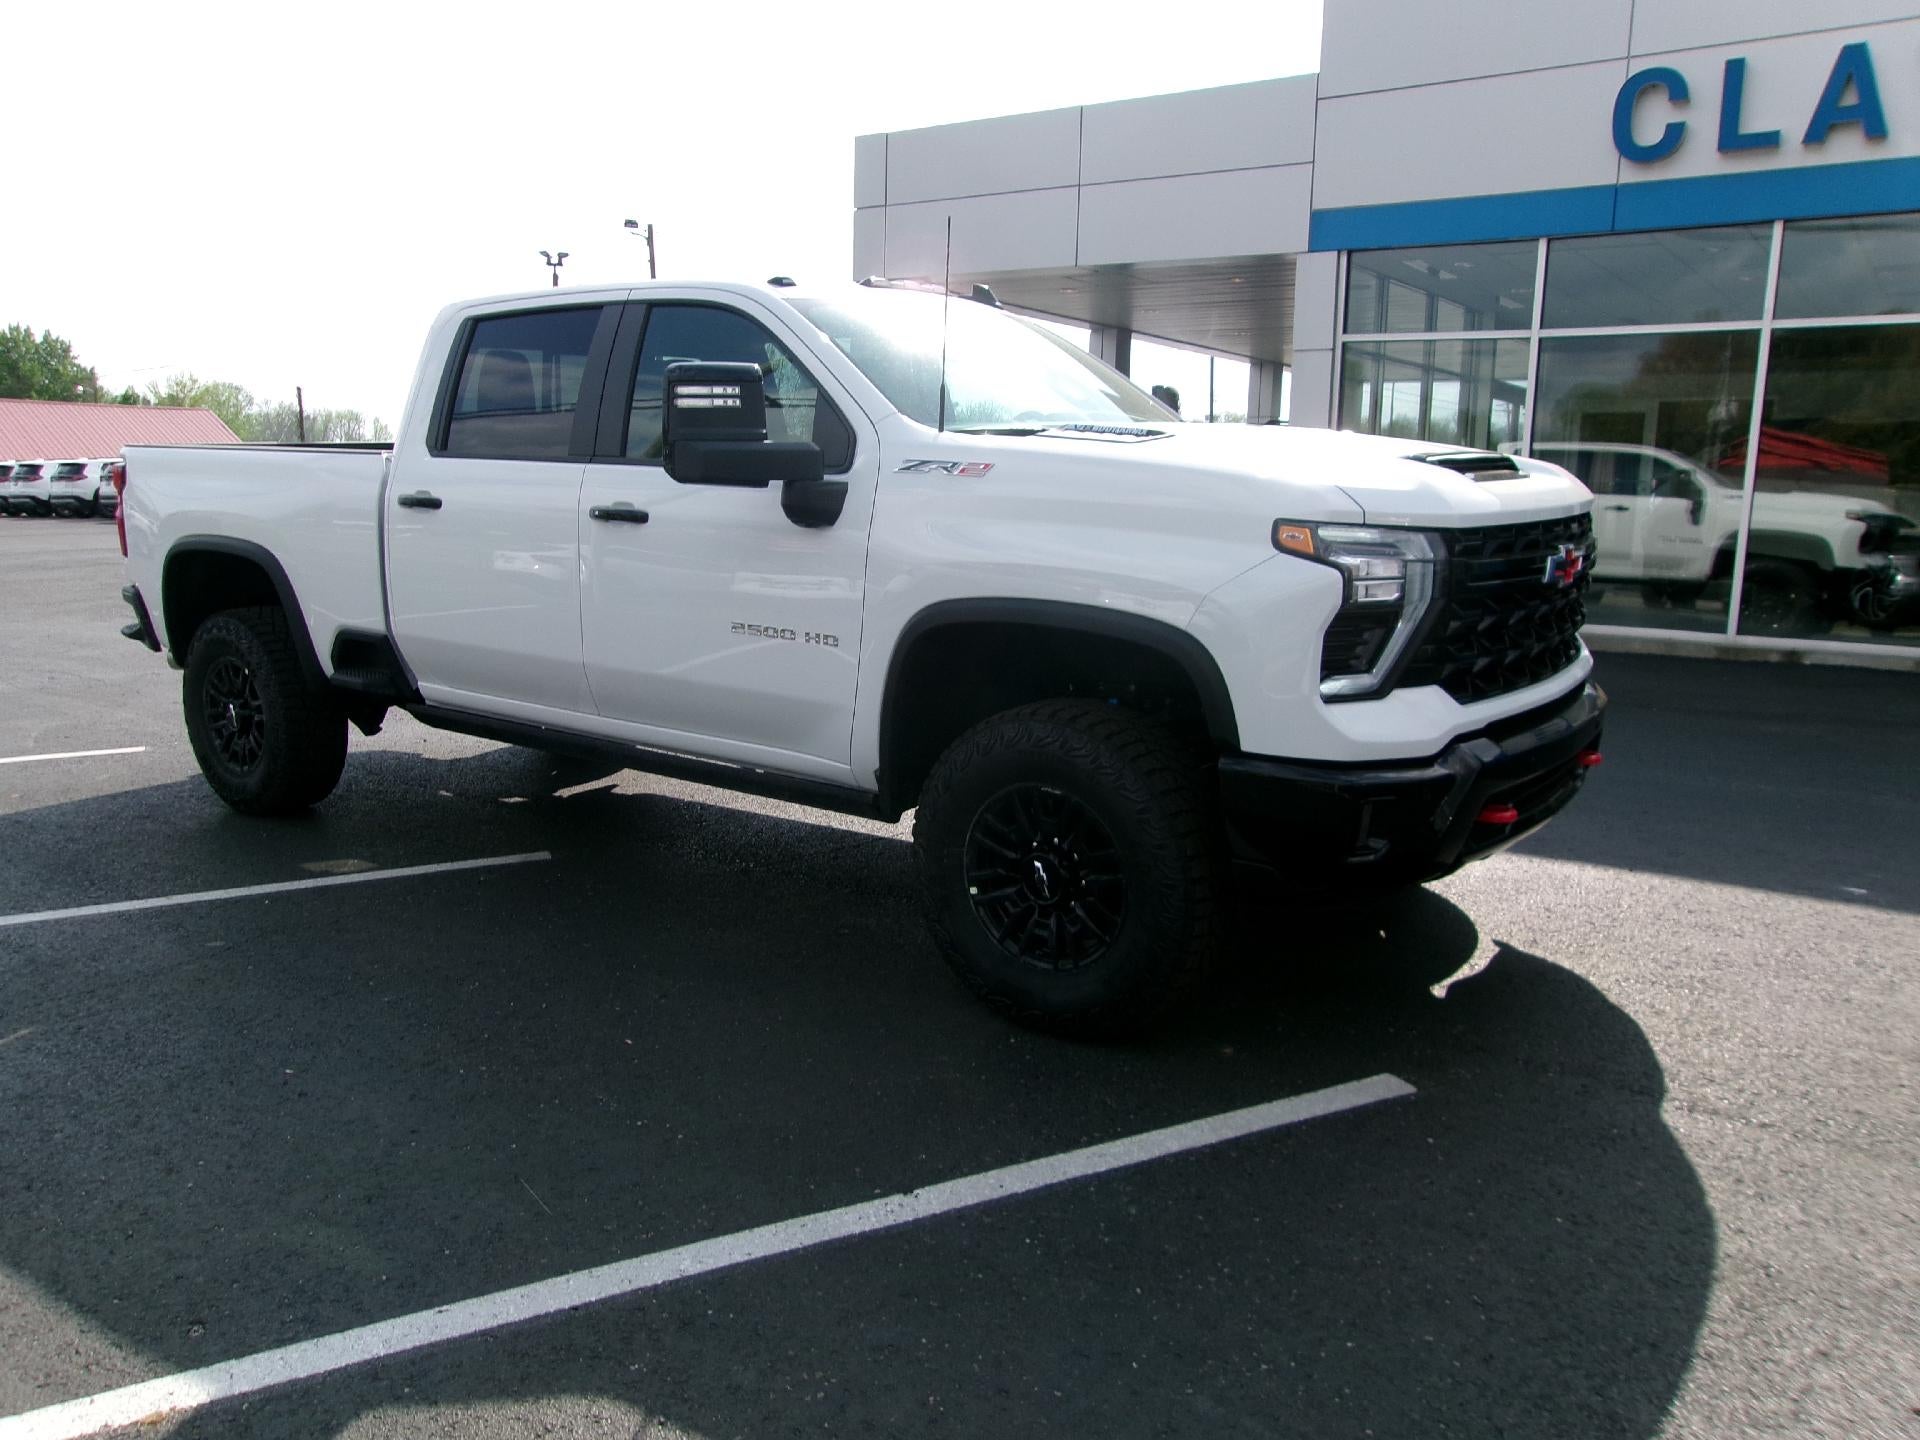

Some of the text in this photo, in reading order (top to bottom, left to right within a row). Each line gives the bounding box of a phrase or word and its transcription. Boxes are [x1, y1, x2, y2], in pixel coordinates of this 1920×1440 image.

[893, 459, 995, 477] ZR2
[731, 622, 839, 647] 2500 HD
